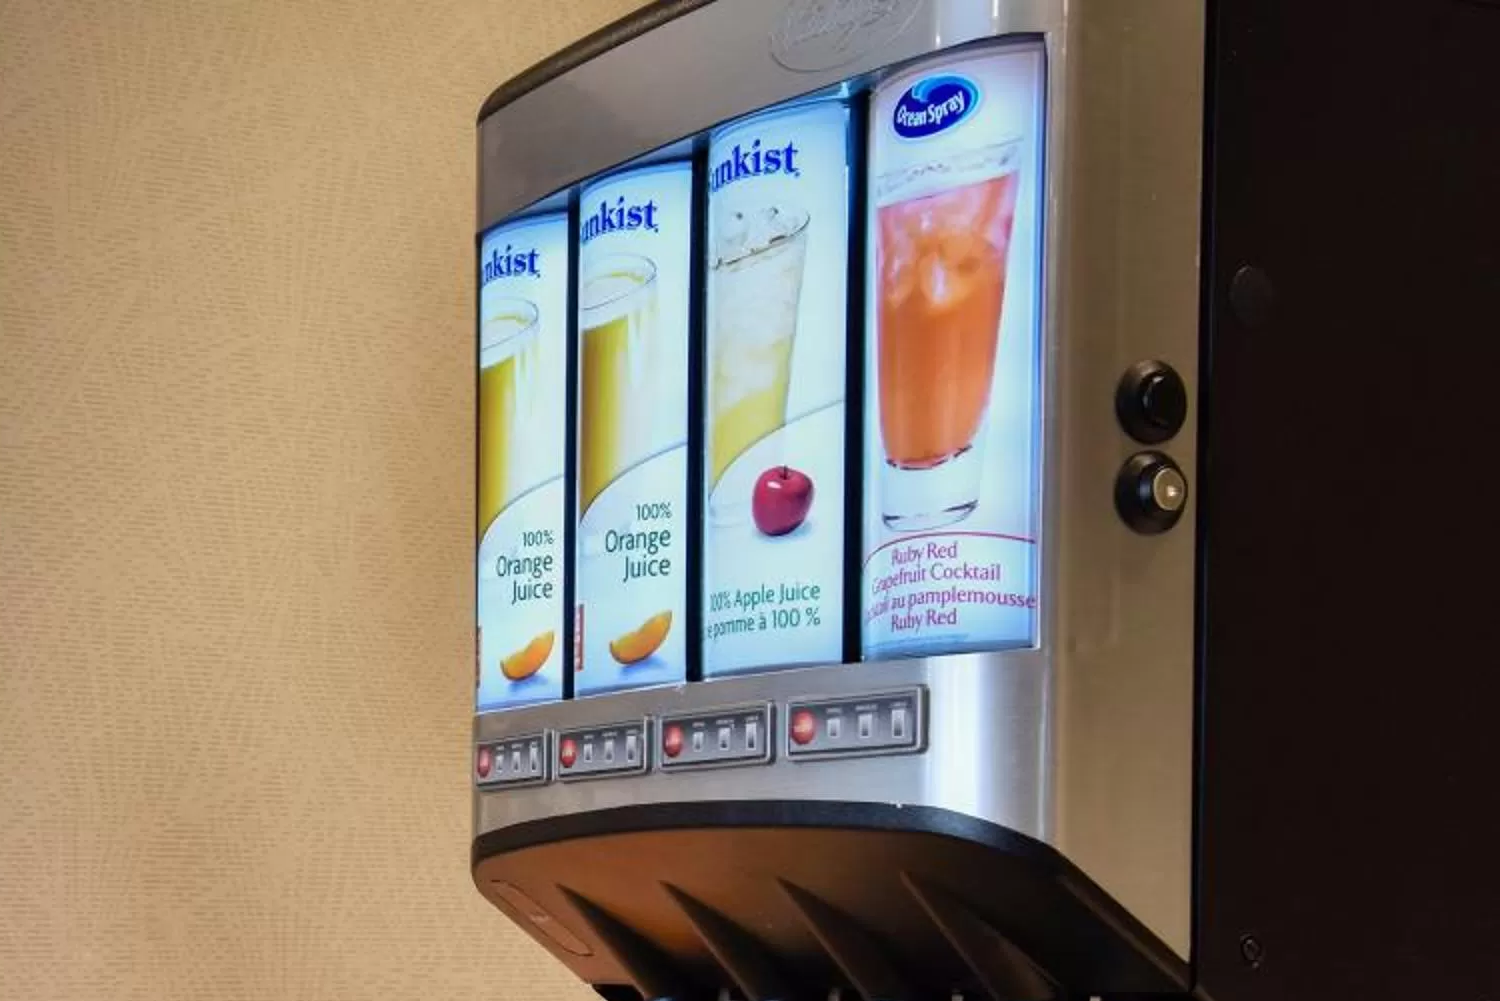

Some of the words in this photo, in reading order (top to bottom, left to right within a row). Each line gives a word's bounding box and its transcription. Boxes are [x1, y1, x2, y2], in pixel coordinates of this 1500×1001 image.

[896, 104, 927, 127] Ocean
[928, 90, 965, 125] Spray
[636, 502, 673, 521] 100%
[523, 530, 555, 548] 100%
[605, 529, 672, 556] Orange
[496, 554, 554, 580] Orange
[891, 546, 923, 567] Ruby
[926, 540, 958, 559] Red
[623, 555, 672, 583] Juice
[930, 562, 1001, 581] Cocktail
[511, 580, 554, 605] Juice
[734, 584, 775, 612] Apple
[779, 583, 821, 604] Juice
[908, 586, 1036, 609] pamplemousse
[713, 617, 755, 640] pomme
[759, 611, 767, 631] à
[772, 607, 801, 629] 100
[805, 606, 821, 626] %
[891, 610, 923, 634] Ruby
[926, 607, 958, 625] Red
